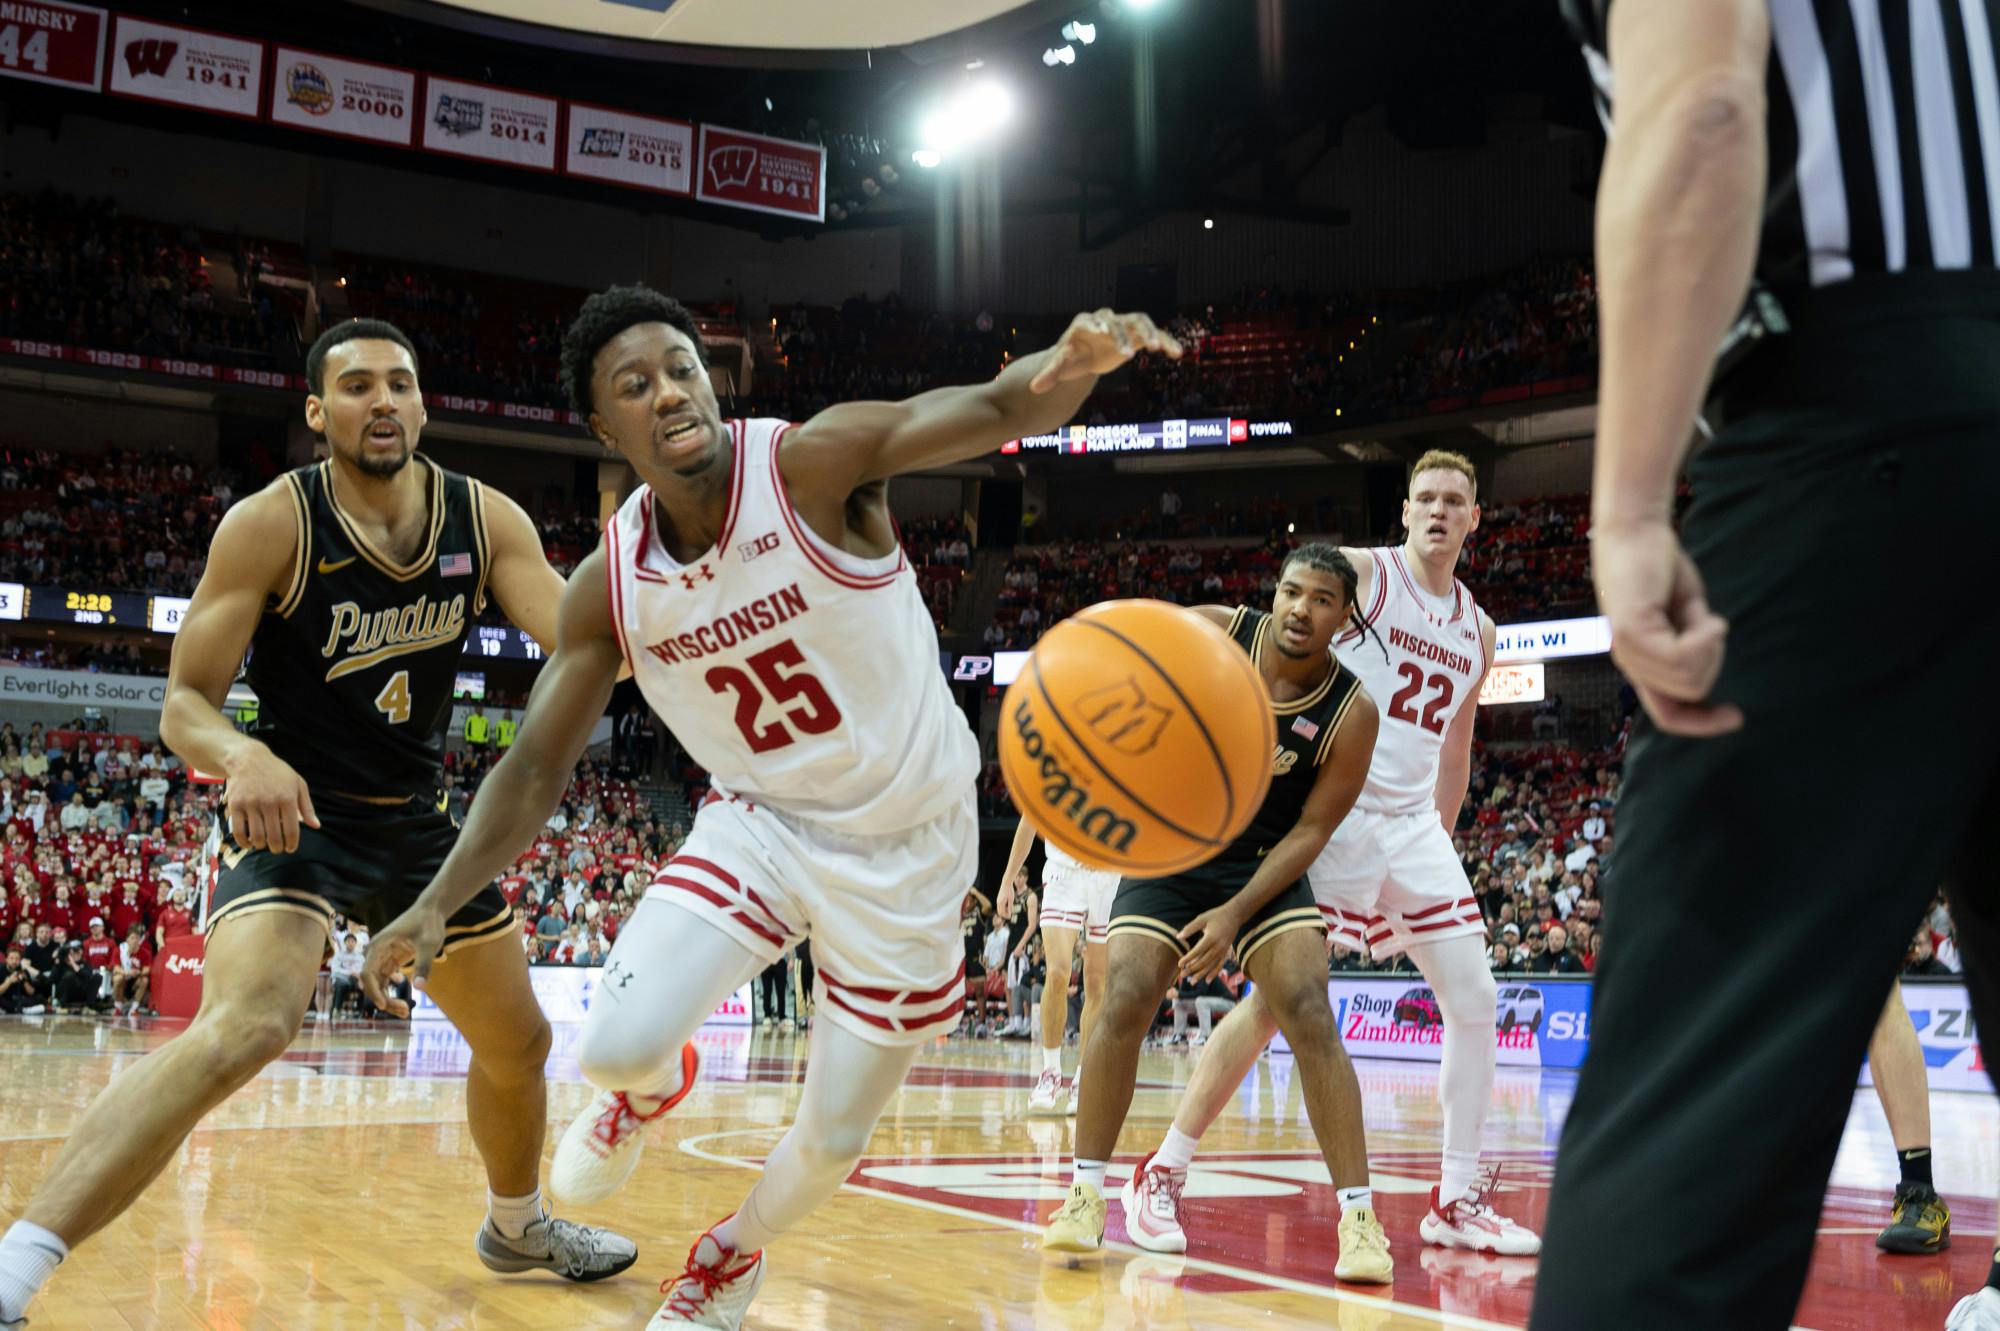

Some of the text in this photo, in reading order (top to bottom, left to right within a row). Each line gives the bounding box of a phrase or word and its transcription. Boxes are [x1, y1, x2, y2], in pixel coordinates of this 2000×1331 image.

[0, 24, 49, 72] 44
[186, 66, 247, 90] 1941
[342, 95, 403, 119] 2000
[490, 122, 546, 145] 2014
[628, 148, 681, 170] 2015
[759, 176, 812, 200] 1941
[11, 338, 64, 360] 1921
[87, 348, 141, 370] 1923
[160, 358, 215, 379] 1924
[440, 394, 489, 414] 1947
[1087, 424, 1139, 439] OREGON
[1189, 423, 1222, 438] FINAL
[1249, 422, 1292, 436] TOYOTA
[1021, 434, 1060, 449] TOYOTA
[1086, 436, 1155, 452] MARYLAND
[66, 592, 112, 612] 2:28
[74, 610, 103, 624] 2ND
[321, 593, 466, 658] Purdue
[646, 582, 810, 666] WISCONSIN
[1389, 626, 1472, 676] WISCONSIN
[1496, 632, 1566, 651] al in WI
[3, 675, 89, 699] Everlight
[94, 681, 145, 701] Solar
[374, 670, 412, 725] 4
[705, 638, 842, 754] 25
[1387, 661, 1454, 737] 22
[1014, 697, 1140, 856] Wilson
[1351, 993, 1392, 1018] Shop
[1345, 1013, 1443, 1046] Zimbrick
